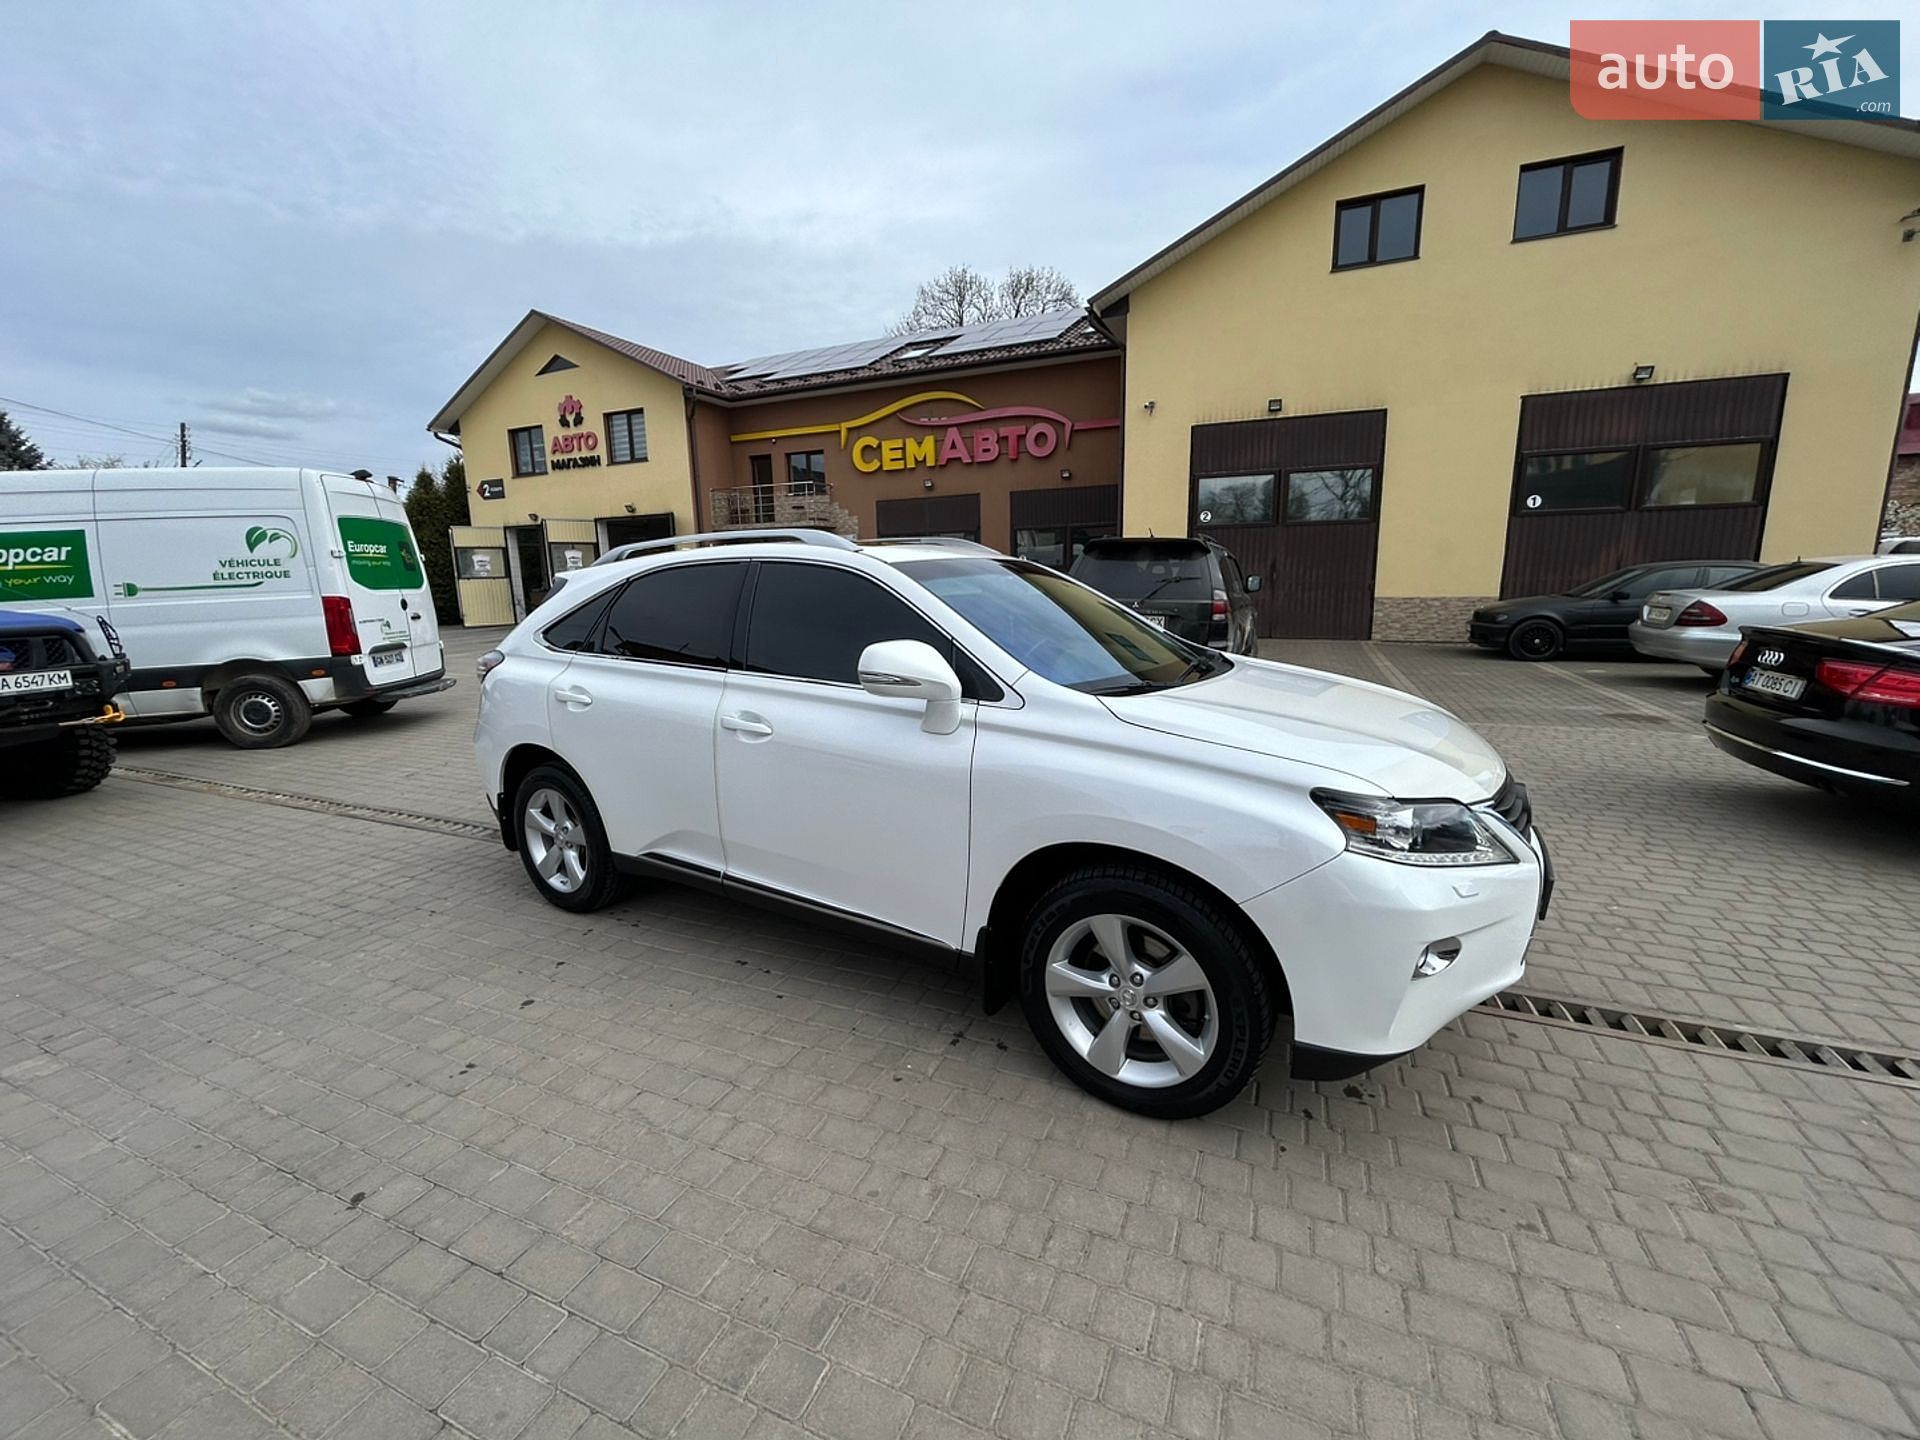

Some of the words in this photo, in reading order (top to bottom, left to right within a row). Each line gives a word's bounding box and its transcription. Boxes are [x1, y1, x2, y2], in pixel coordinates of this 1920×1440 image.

[550, 430, 599, 455] АВТО
[550, 454, 602, 471] МАГАЗИН
[482, 484, 491, 497] 2
[347, 540, 388, 556] Europcar
[219, 557, 282, 568] VÉHICULE
[5, 576, 41, 587] your
[43, 574, 75, 585] way
[212, 570, 291, 581] ÉLECTRIQUE
[15, 674, 45, 689] 6547
[48, 671, 69, 685] KM
